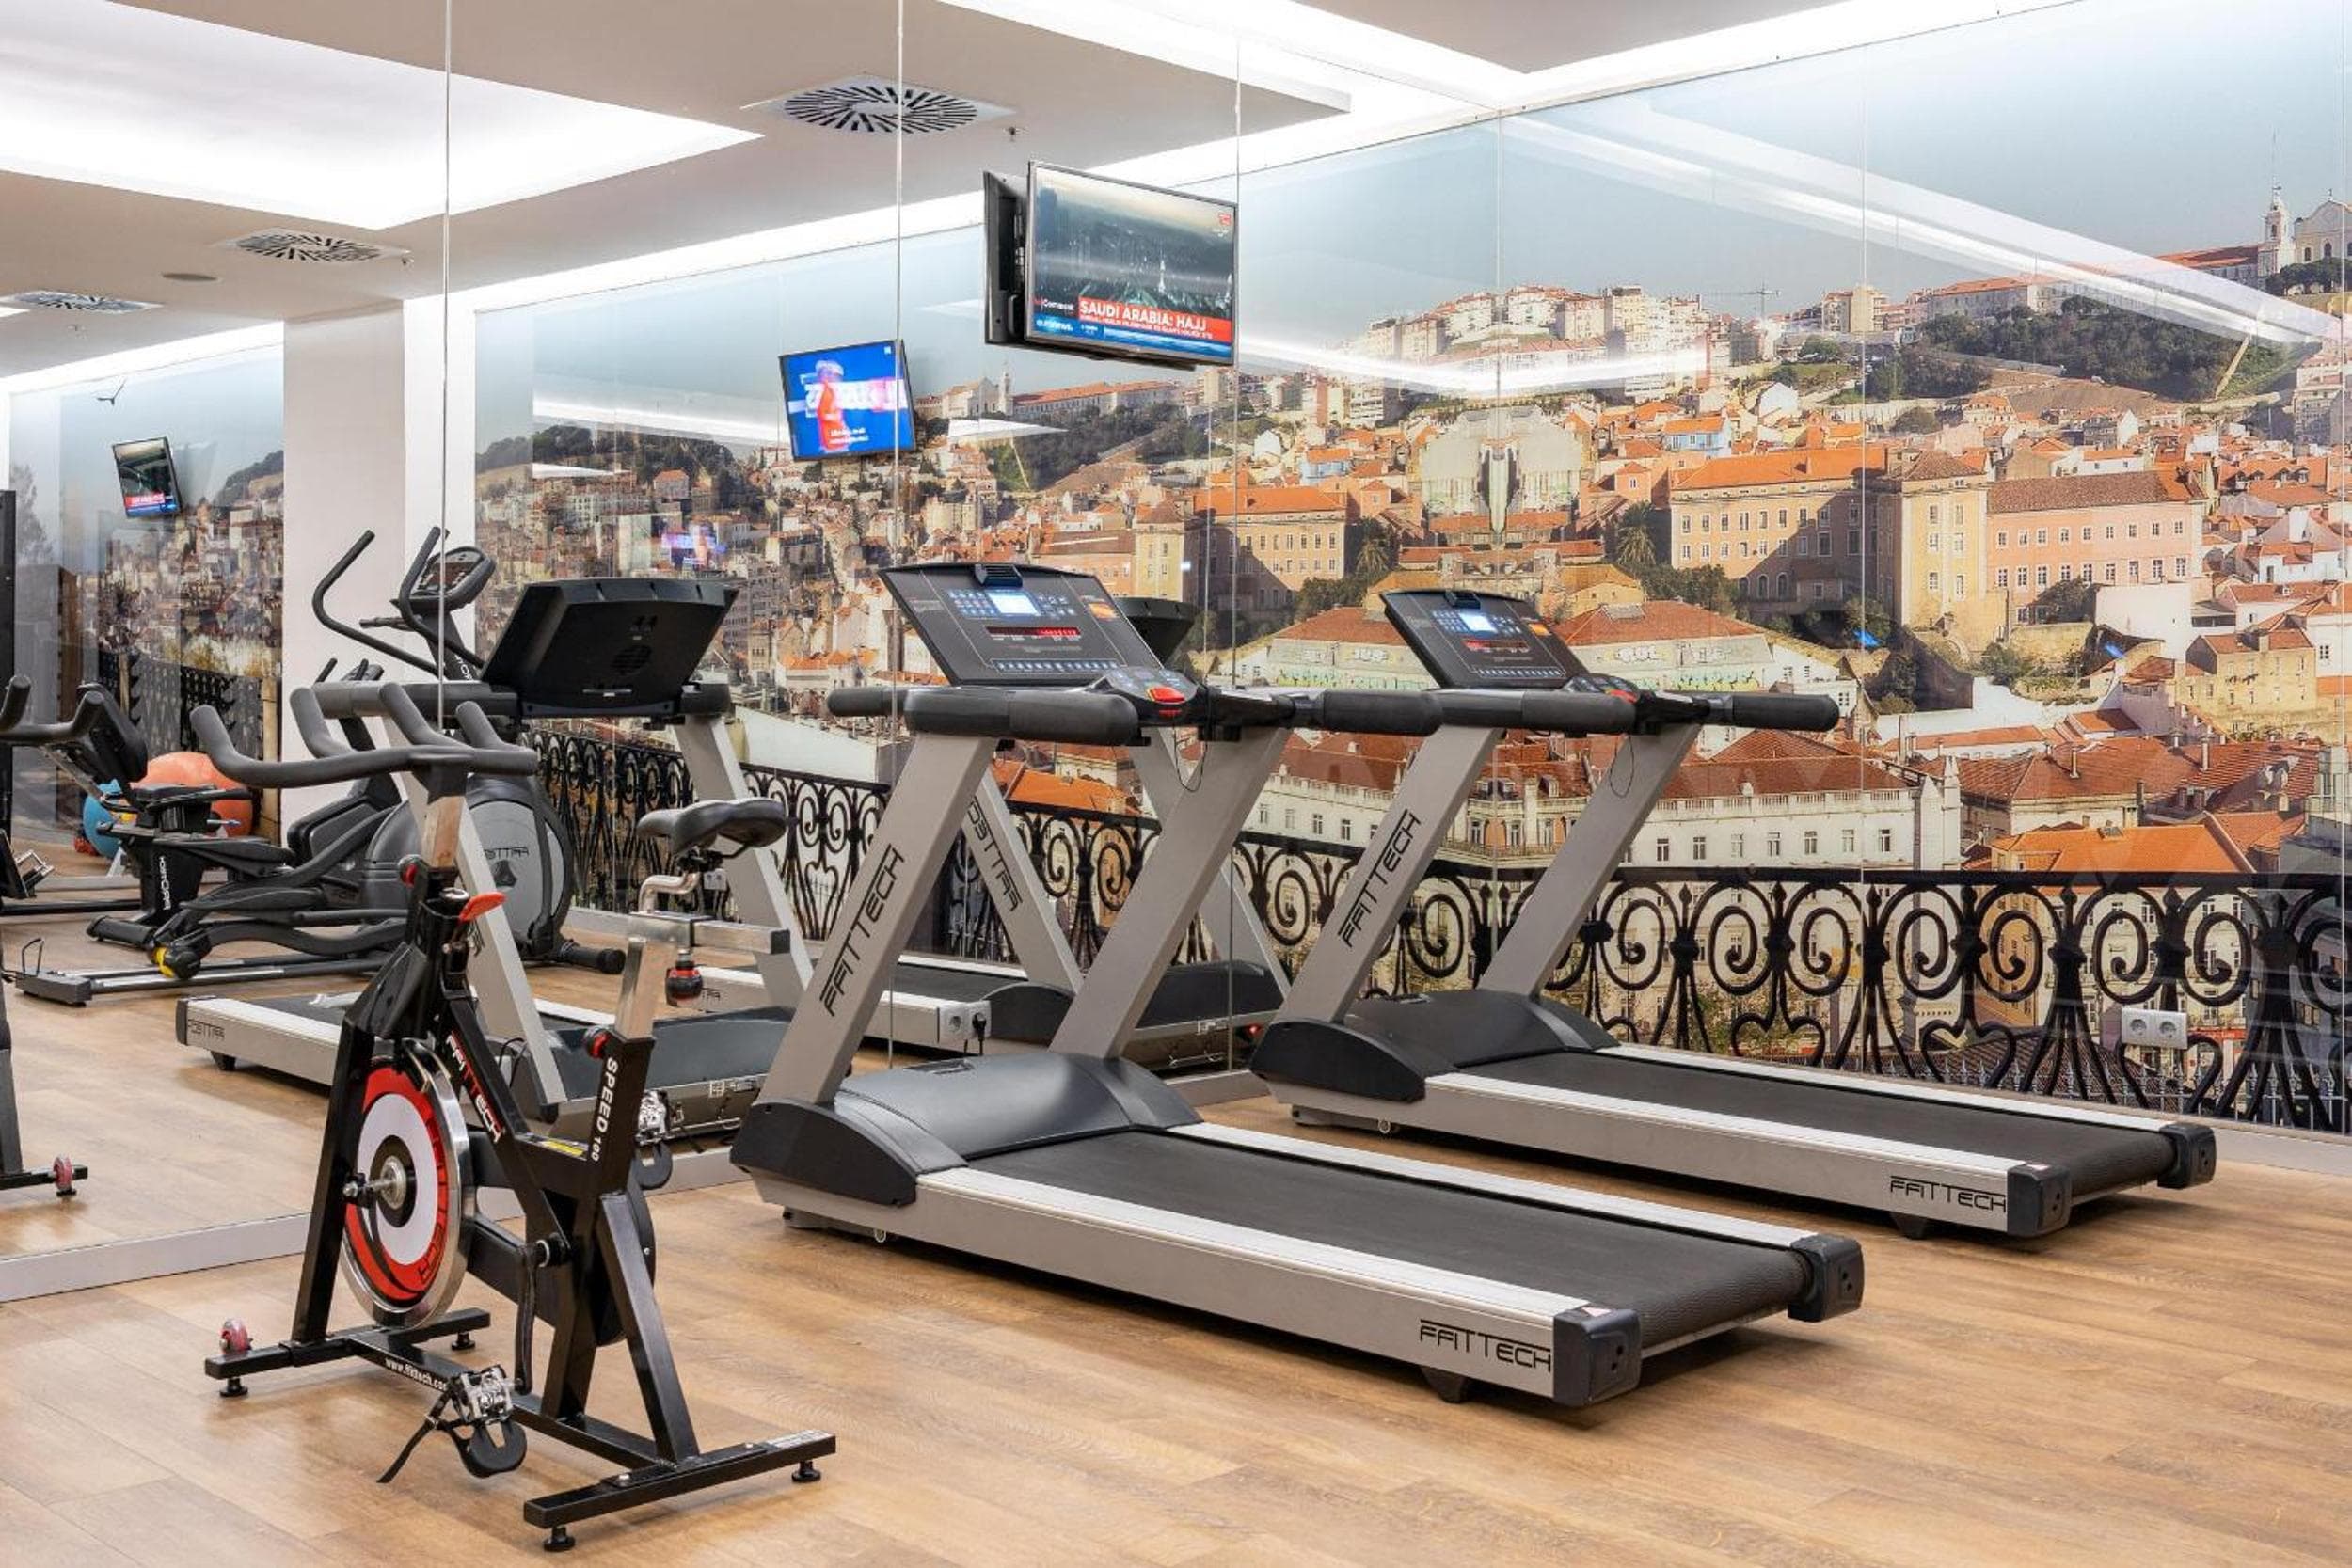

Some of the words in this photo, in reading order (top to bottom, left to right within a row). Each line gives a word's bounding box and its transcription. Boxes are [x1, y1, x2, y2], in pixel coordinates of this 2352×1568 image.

[1080, 300, 1120, 319] SAUDI
[1122, 306, 1173, 326] ARABIA:
[1176, 315, 1207, 332] HAJJ
[596, 1056, 619, 1133] SPEED
[591, 1136, 602, 1162] 100
